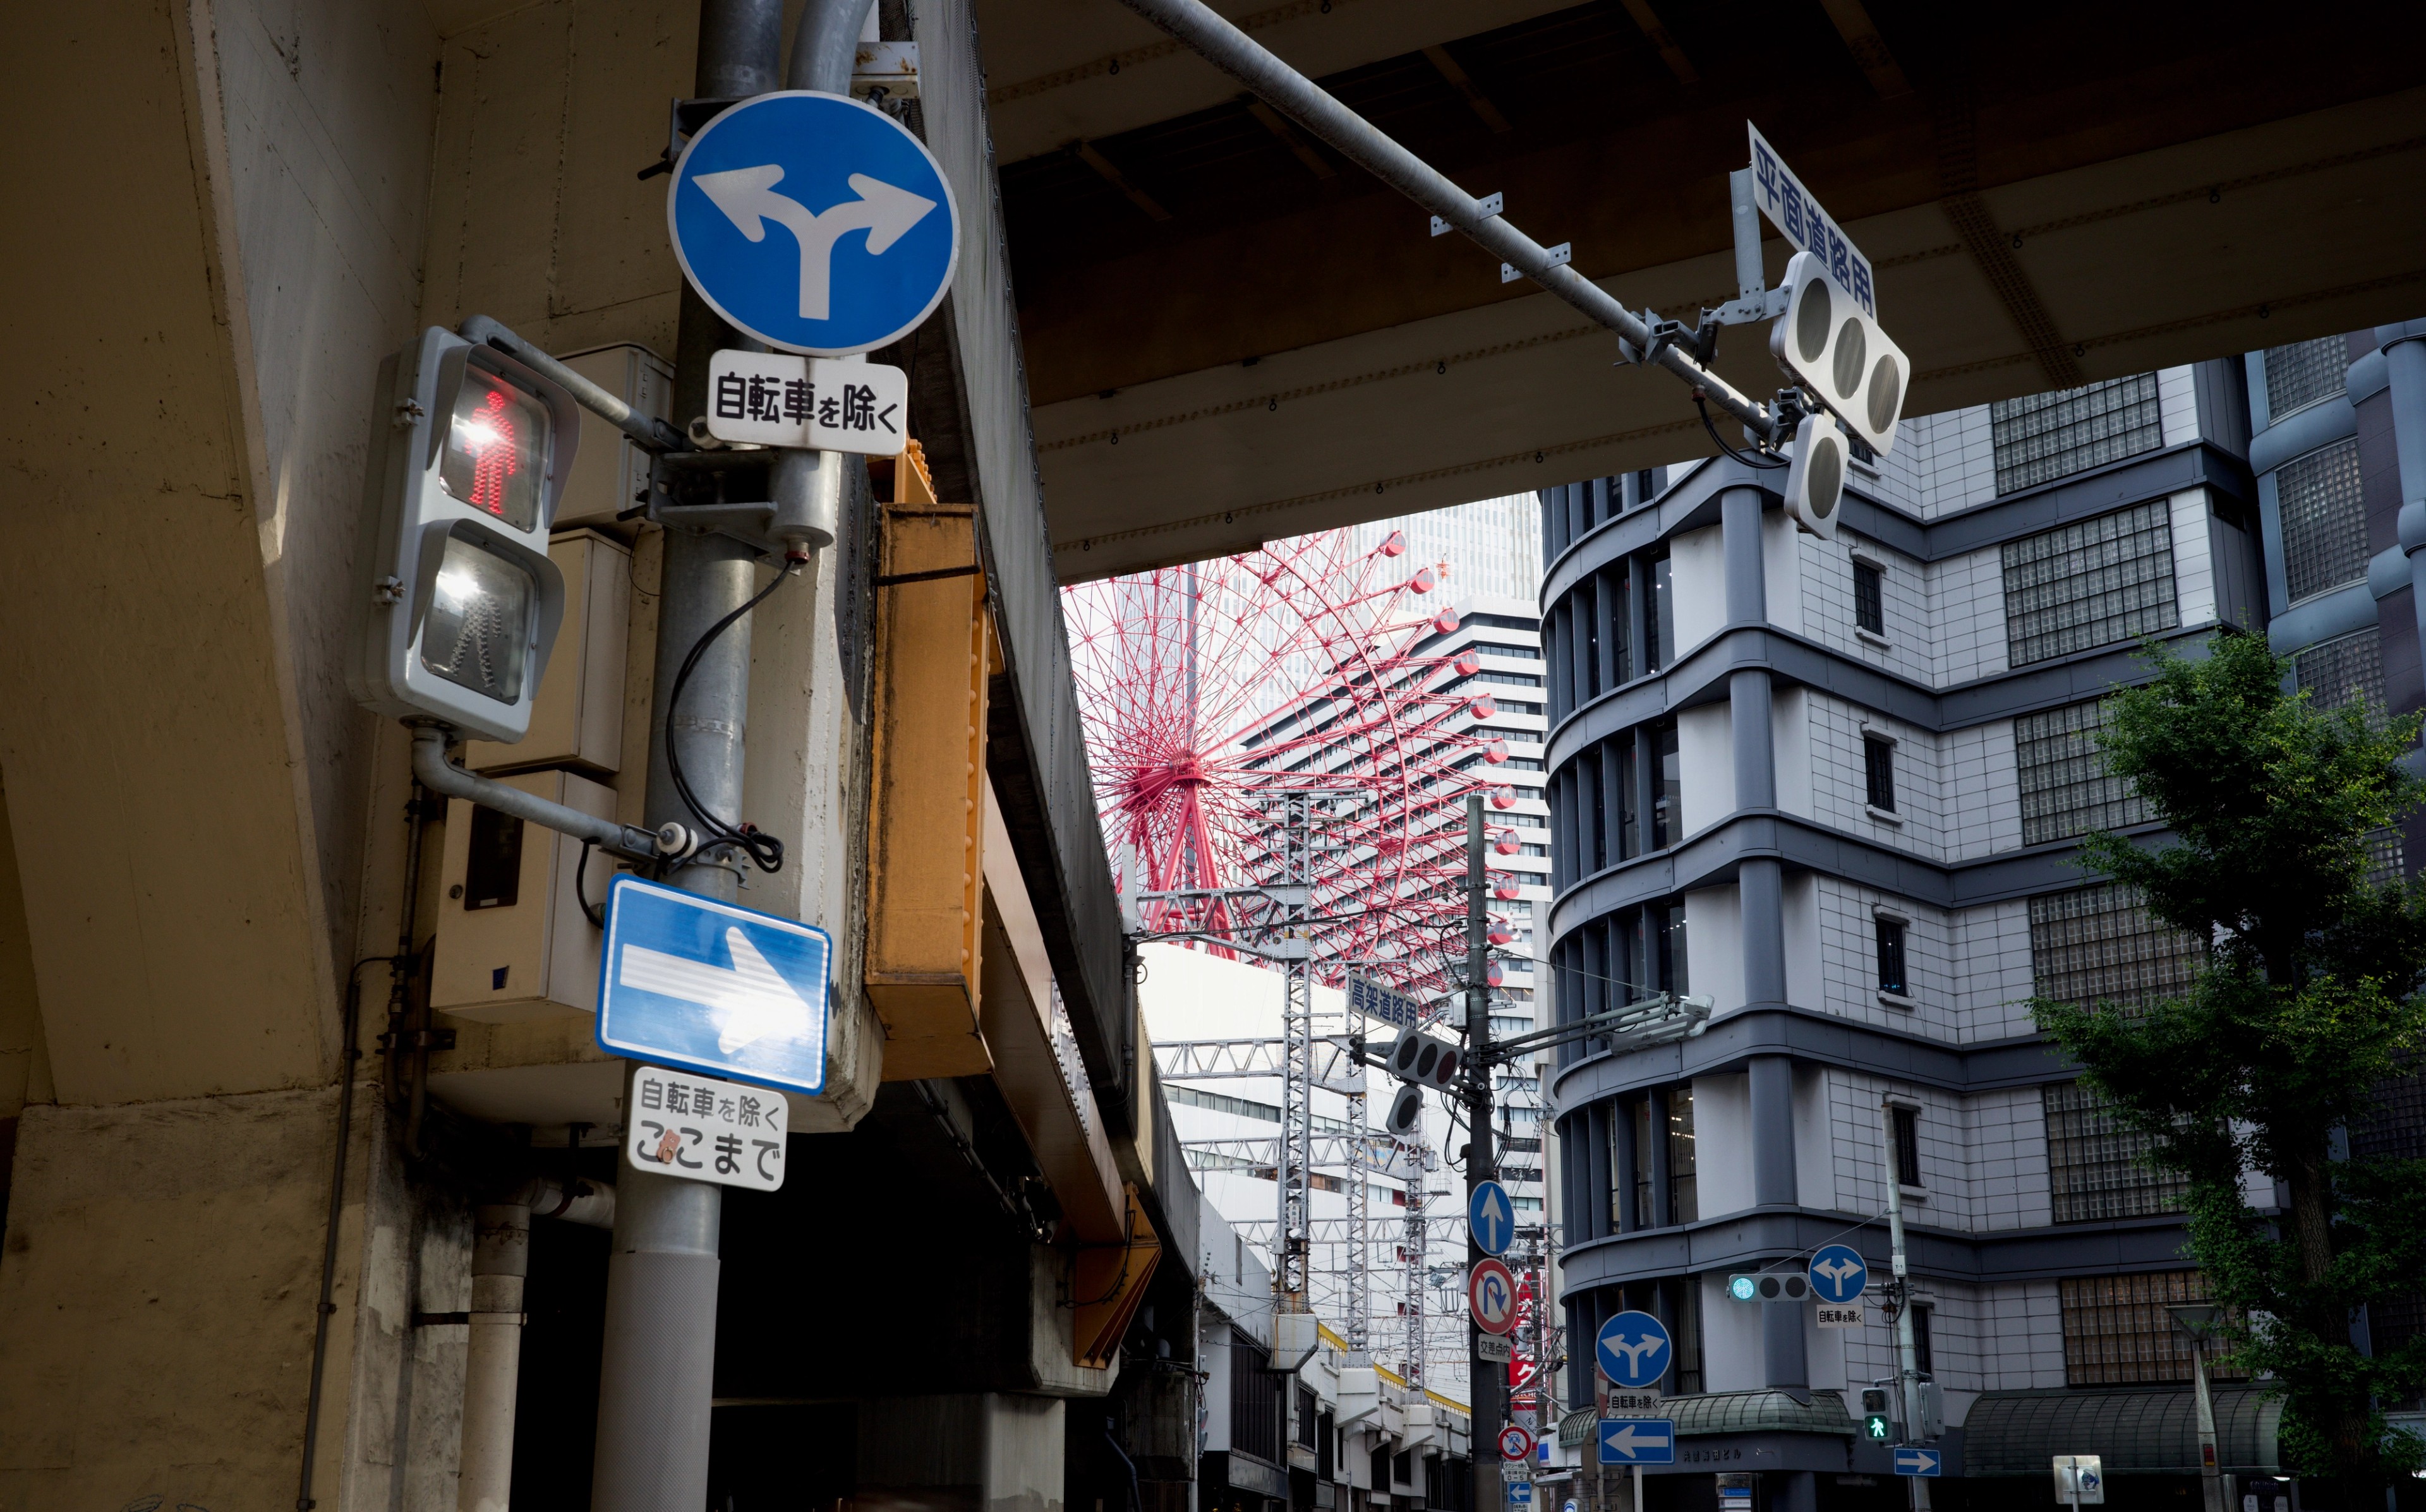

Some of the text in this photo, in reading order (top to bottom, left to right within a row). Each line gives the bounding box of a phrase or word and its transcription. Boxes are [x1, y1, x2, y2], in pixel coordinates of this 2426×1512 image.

[1754, 138, 1874, 320] 平面道路用
[716, 371, 898, 434] 自転車を除く
[1352, 978, 1416, 1029] 高架道路用
[641, 1077, 779, 1131] 自転車を除く
[637, 1119, 780, 1182] ここまで
[1819, 1310, 1862, 1323] 自転車を除く
[1481, 1340, 1510, 1357] 交差点内
[1612, 1395, 1658, 1409] 自転車を除く
